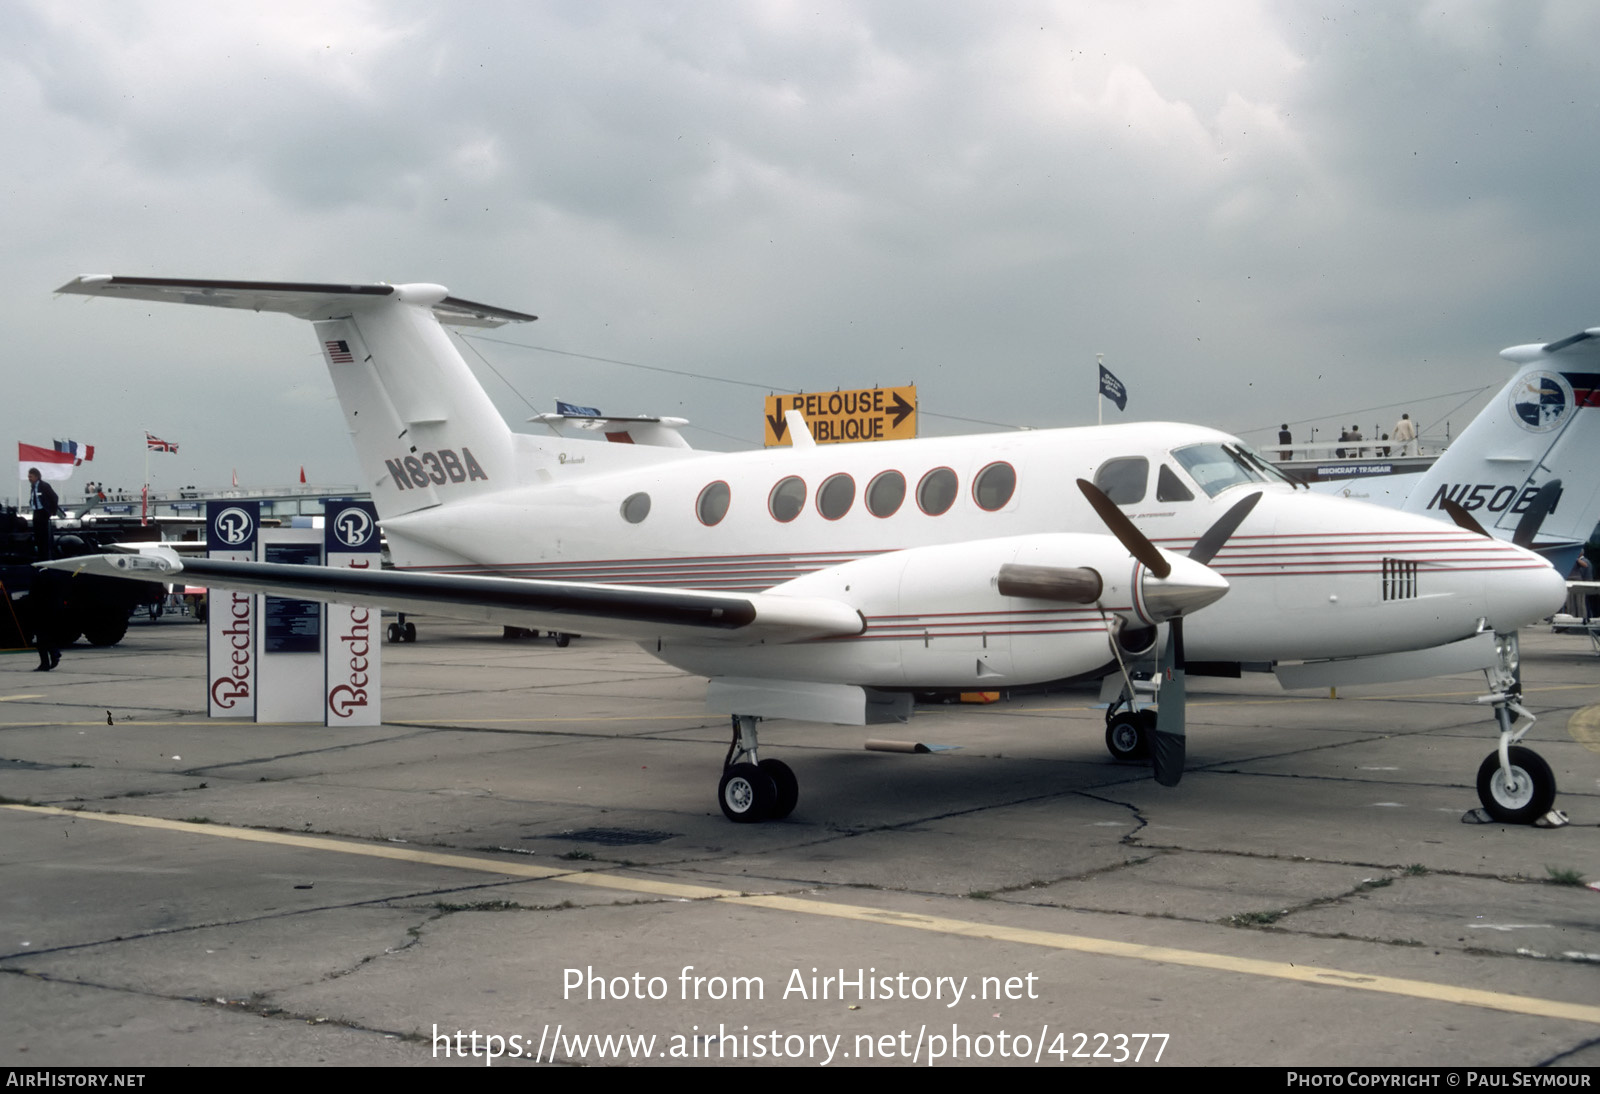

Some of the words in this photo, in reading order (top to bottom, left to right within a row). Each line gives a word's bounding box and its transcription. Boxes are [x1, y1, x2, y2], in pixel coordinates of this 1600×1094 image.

[793, 391, 884, 416] PELOUSE
[806, 417, 884, 441] UBLIQUE
[385, 447, 488, 490] N83BA
[1426, 483, 1564, 515] N150B
[211, 557, 250, 709] Beechcr
